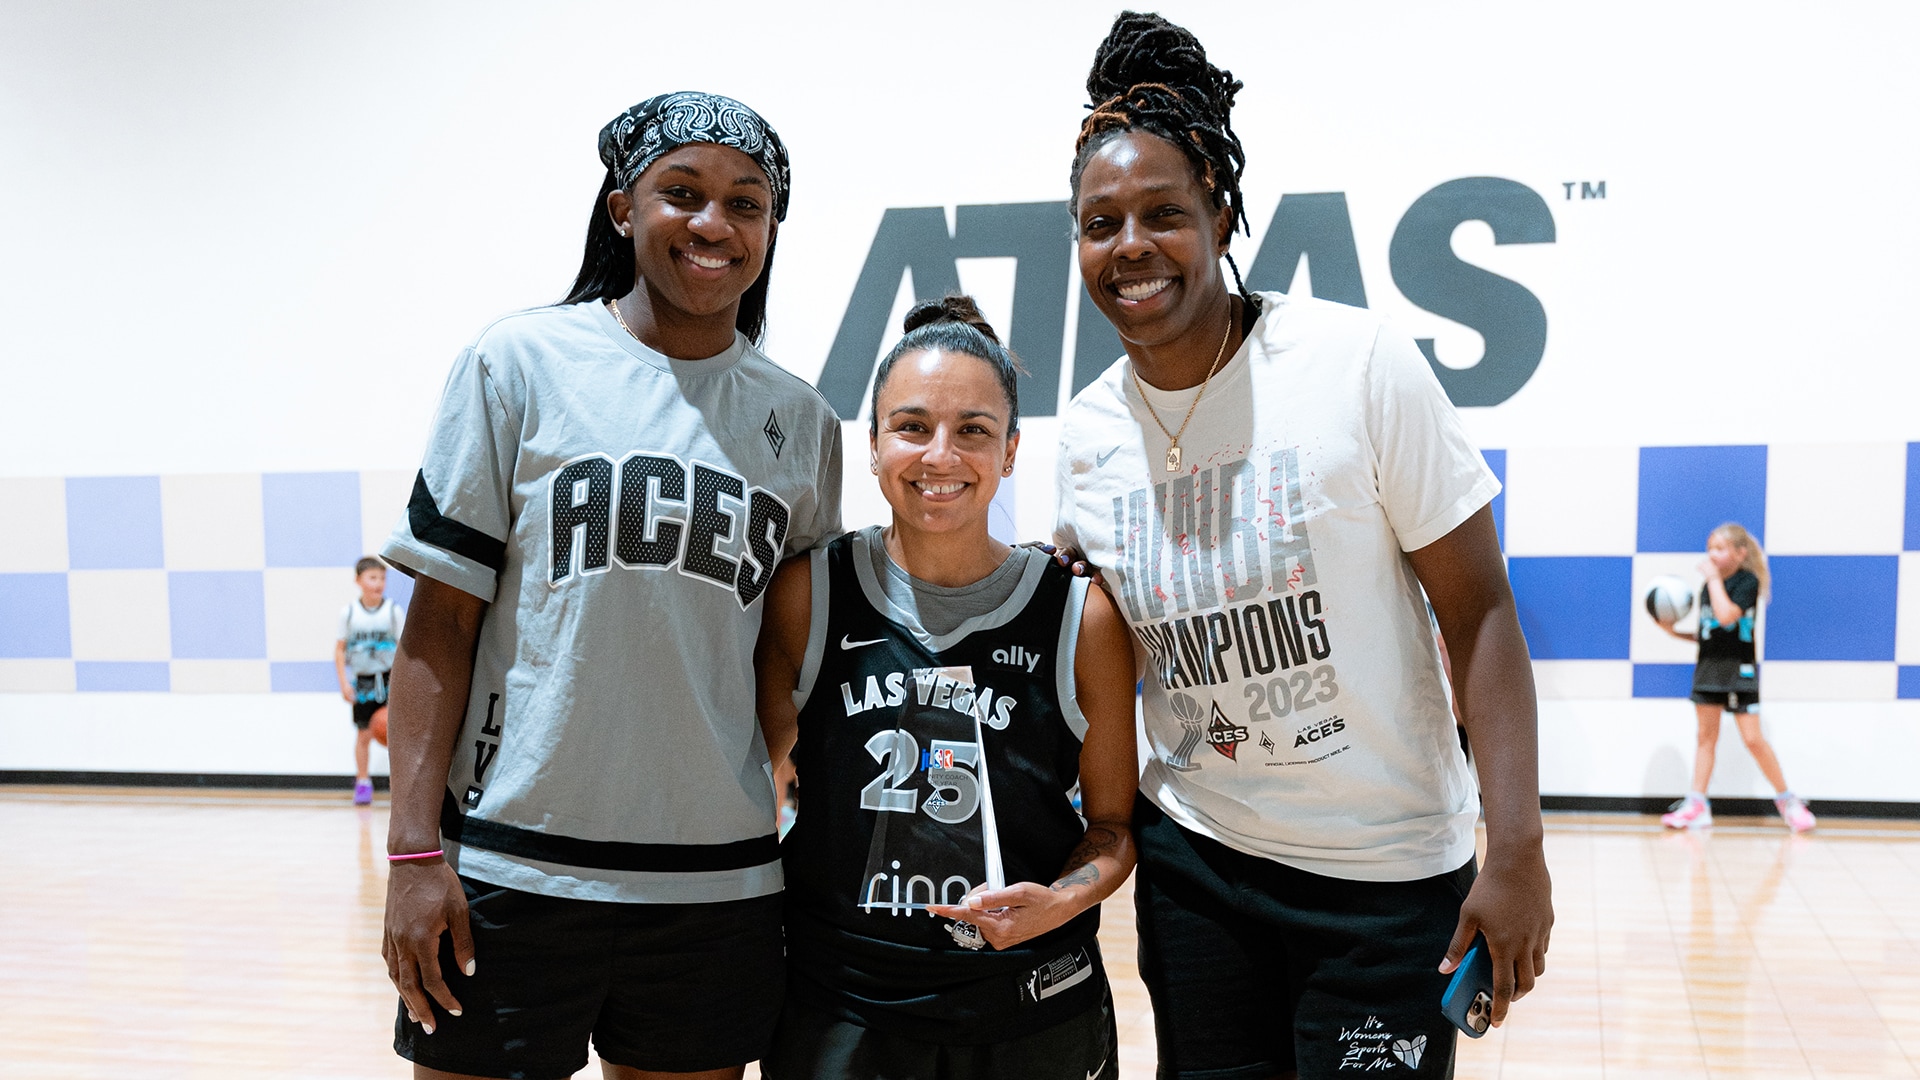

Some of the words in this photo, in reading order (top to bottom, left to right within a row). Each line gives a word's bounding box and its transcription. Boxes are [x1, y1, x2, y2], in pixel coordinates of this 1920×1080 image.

[1561, 180, 1606, 200] TM
[547, 450, 791, 612] ACES
[1112, 446, 1318, 621] WNBA
[991, 645, 1041, 673] ally
[840, 671, 906, 717] LAS
[914, 670, 1018, 731] VEGAS
[1244, 664, 1339, 722] 2023
[1293, 718, 1346, 748] ACES
[1314, 715, 1338, 727] VEGAS
[1307, 753, 1330, 765] PRODUCT
[859, 728, 982, 824] 25
[1363, 1015, 1385, 1029] It's
[1338, 1056, 1366, 1070] For
[1365, 1057, 1397, 1071] Me
[1345, 1041, 1389, 1058] Sports
